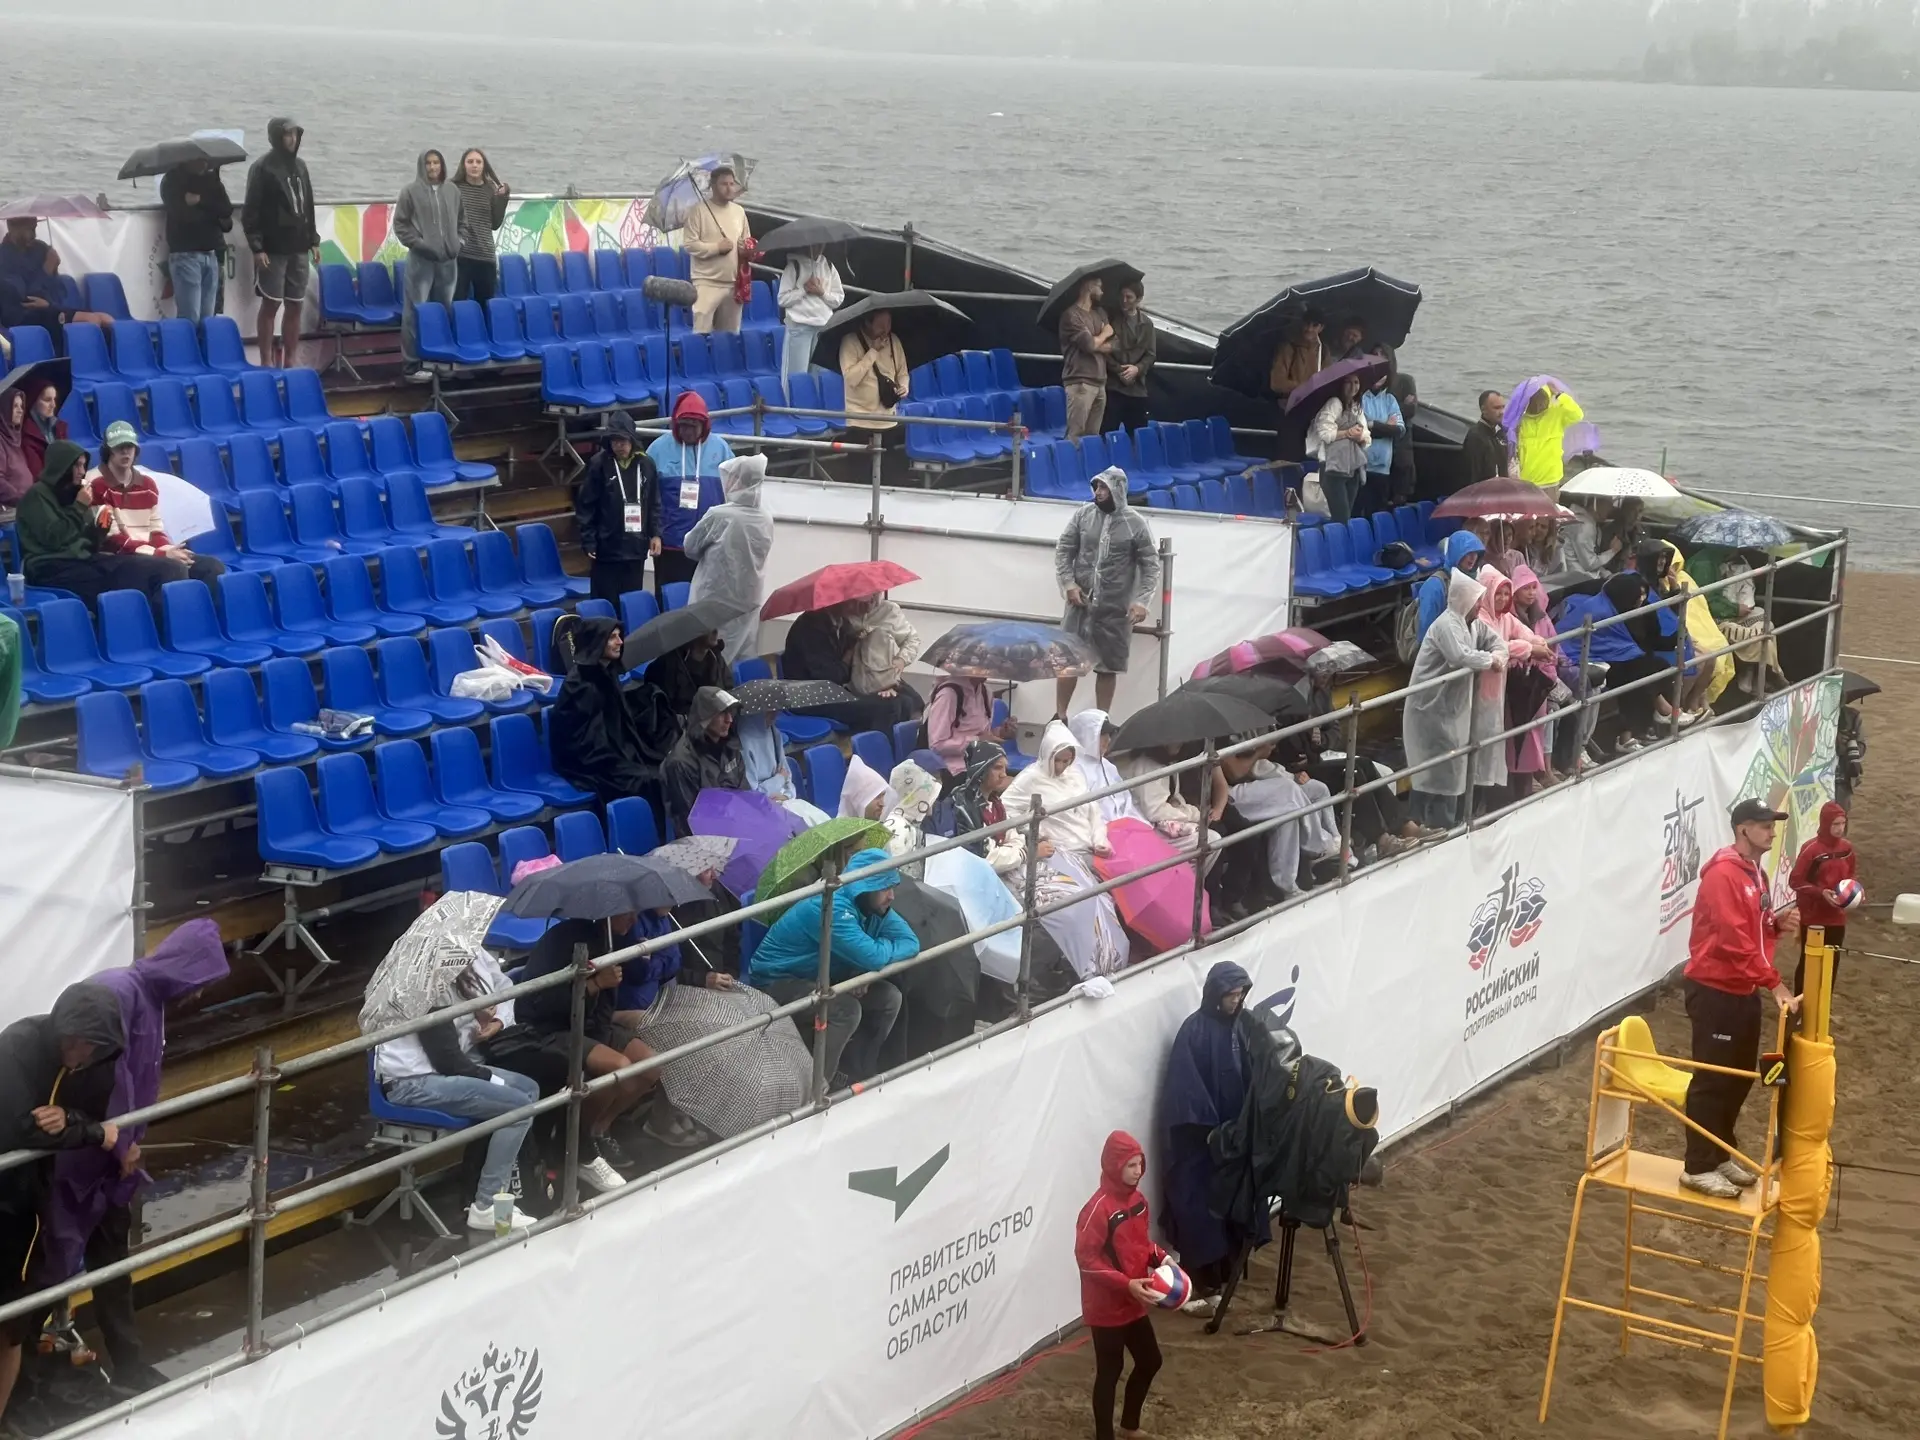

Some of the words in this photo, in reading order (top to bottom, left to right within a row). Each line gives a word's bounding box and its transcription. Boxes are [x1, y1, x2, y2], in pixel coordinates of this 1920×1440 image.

[1463, 995, 1512, 1042] СПОРТИВНЫЙ
[1513, 985, 1537, 1009] ФОНД
[1465, 951, 1540, 1020] РОССИЙСКИЙ
[890, 1205, 1033, 1295] ПРАВИТЕЛЬСТВО
[888, 1250, 996, 1327] САМАРСКОЙ
[887, 1298, 968, 1361] ОБЛАСТИ
